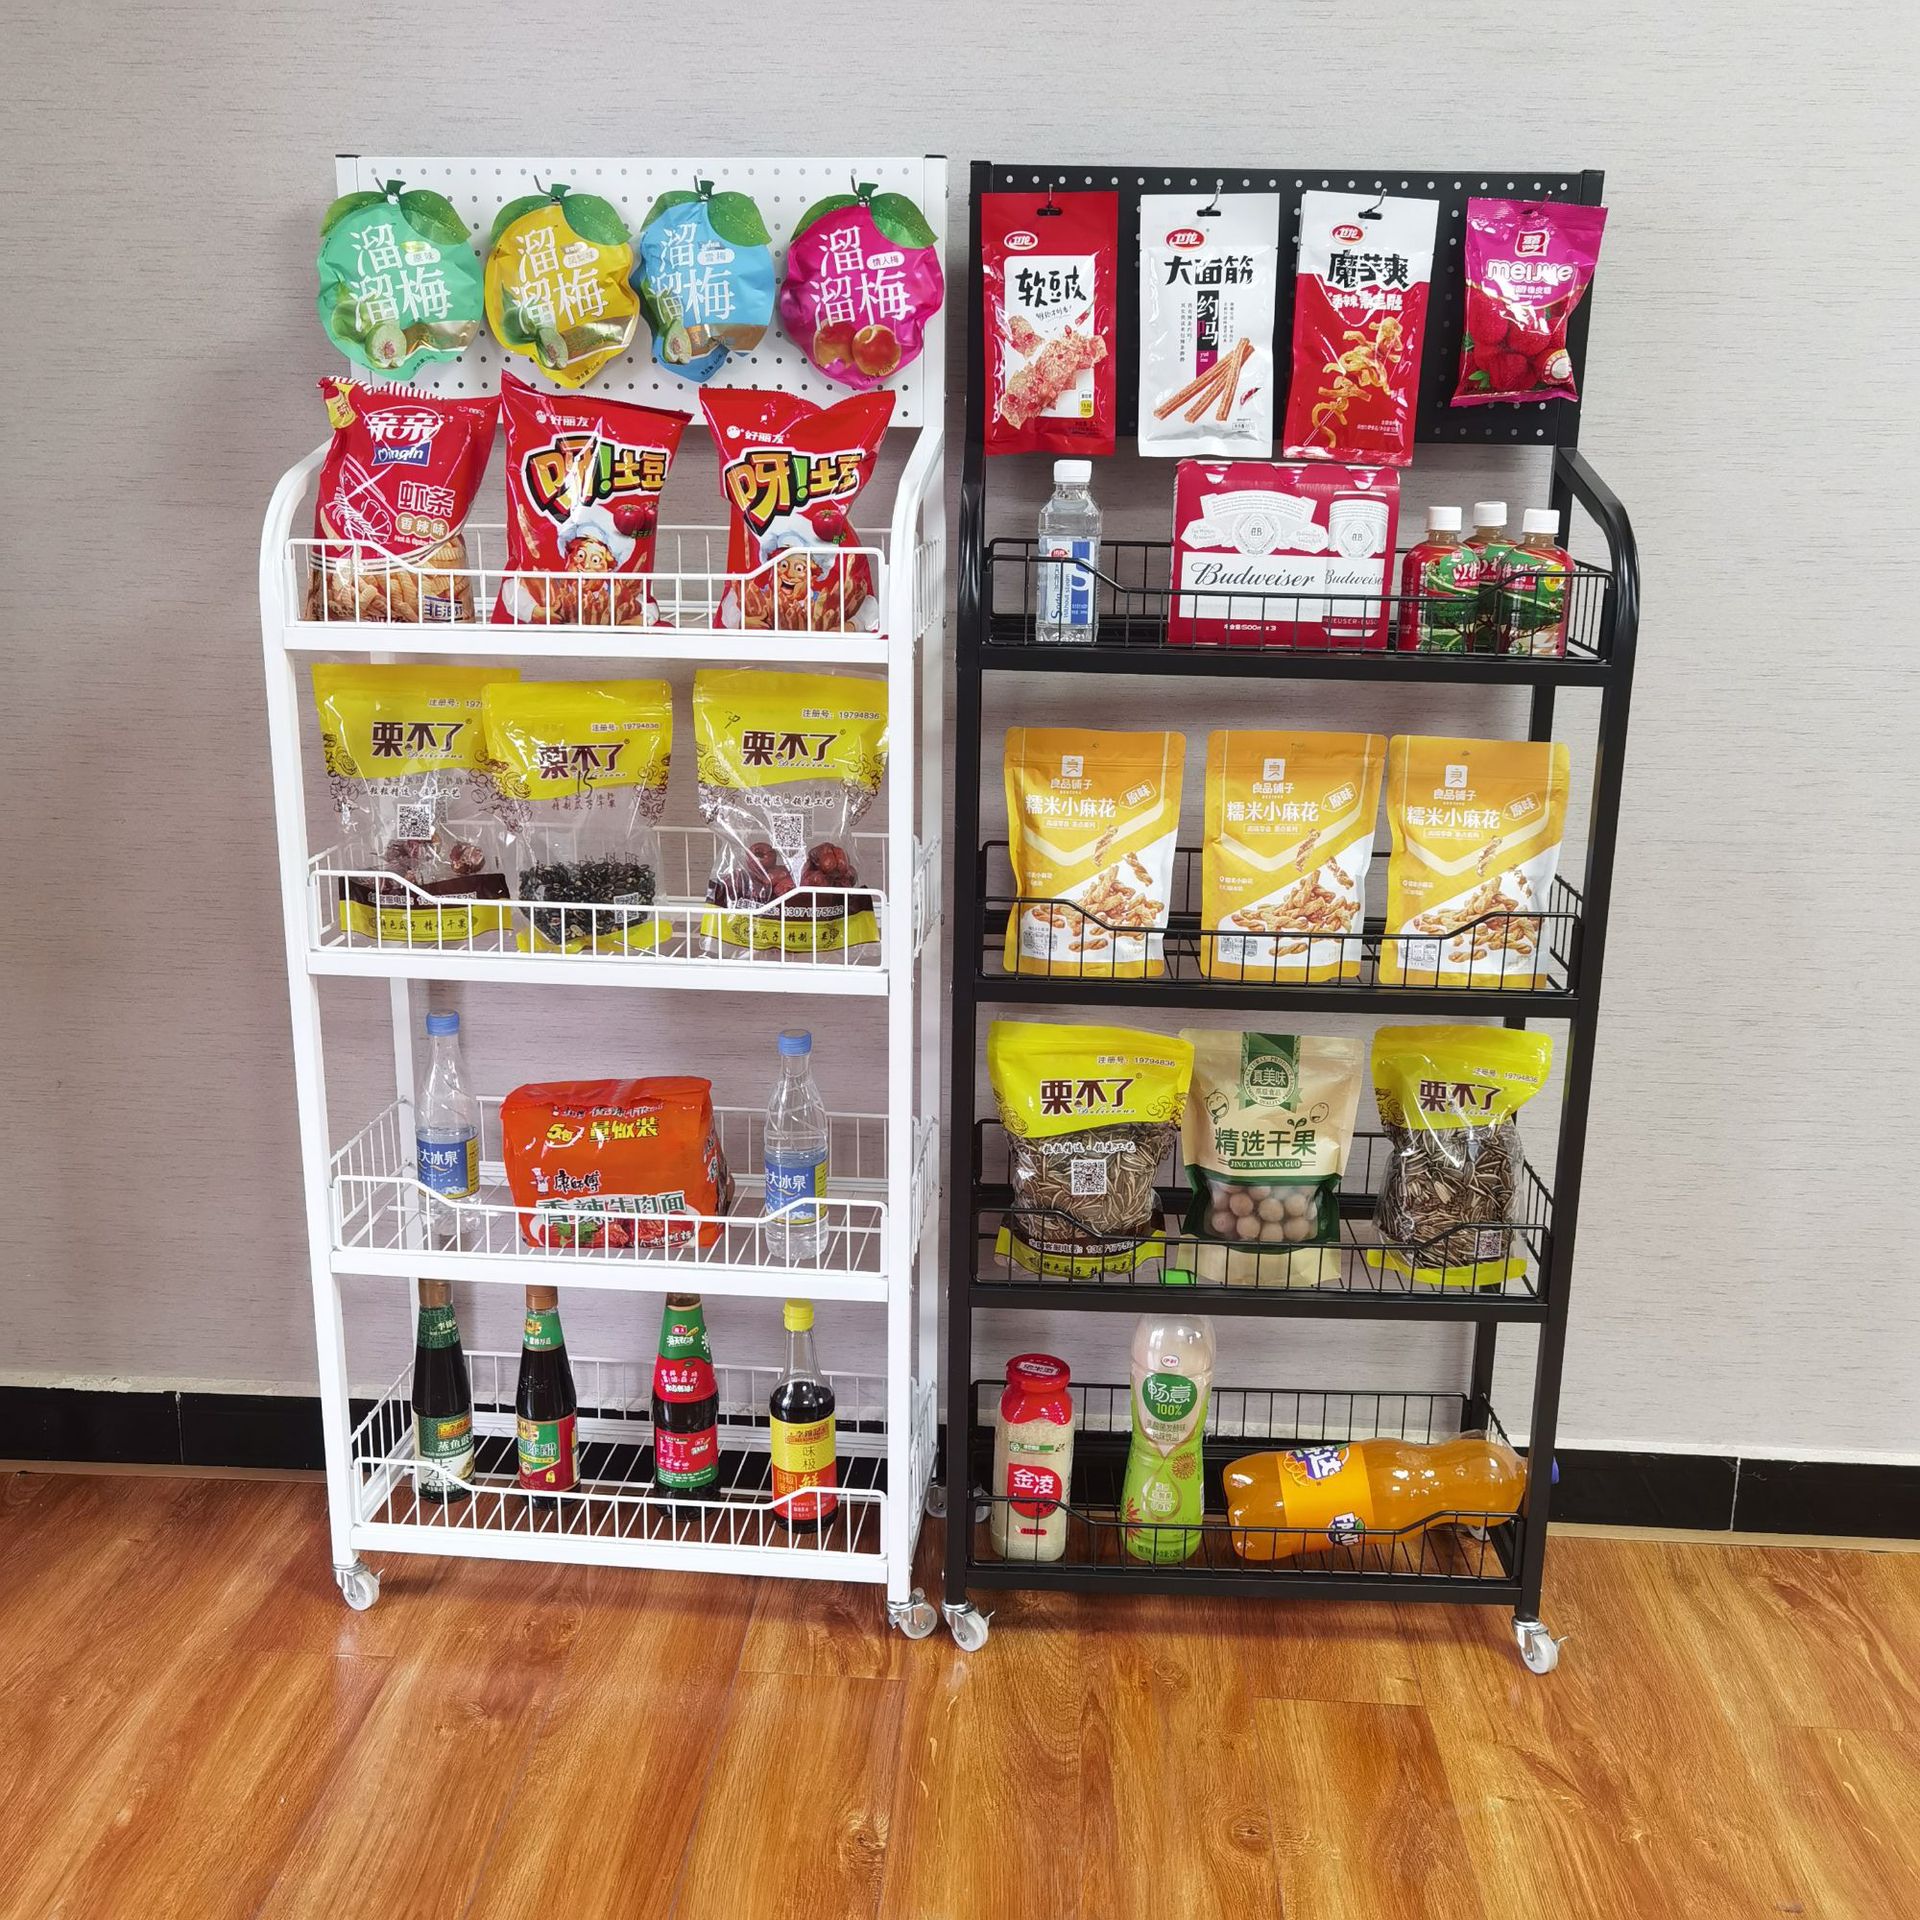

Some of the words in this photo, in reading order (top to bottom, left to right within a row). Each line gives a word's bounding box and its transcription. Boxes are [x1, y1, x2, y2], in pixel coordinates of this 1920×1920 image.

[1164, 255, 1254, 286] 大面筋
[1327, 249, 1409, 289] 魔芋爽
[550, 415, 589, 427] 好丽友
[744, 430, 784, 444] 好丽友
[399, 481, 454, 516] 虾条
[401, 517, 445, 536] 香辣味
[1191, 562, 1315, 587] Budweiser
[839, 711, 880, 720] 19794836
[372, 721, 464, 757] 栗不了
[743, 731, 837, 766] 栗不了
[540, 744, 624, 779] 栗不了
[1051, 778, 1093, 791] 良品铺子
[1126, 784, 1151, 805] 原味
[1253, 782, 1294, 794] 良品铺子
[1434, 788, 1477, 801] 良品铺子
[1025, 794, 1116, 818] 糯米小麻花
[1329, 788, 1354, 809] 原味
[1511, 797, 1536, 818] 原味
[1227, 801, 1319, 822] 糯米小麻花
[1407, 806, 1500, 829] 糯米小麻花
[1252, 1067, 1287, 1086] 真美味
[1042, 1079, 1134, 1114] 栗不了
[1420, 1079, 1502, 1113] 栗不了
[1215, 1127, 1316, 1157] 精选干果
[1230, 1160, 1247, 1168] JING
[1248, 1160, 1268, 1168] XUAN
[1268, 1160, 1284, 1168] GAN
[1284, 1160, 1301, 1168] GUO
[1147, 1378, 1192, 1404] 畅意
[1156, 1403, 1183, 1416] 100%
[1014, 1469, 1054, 1494] 金凌
